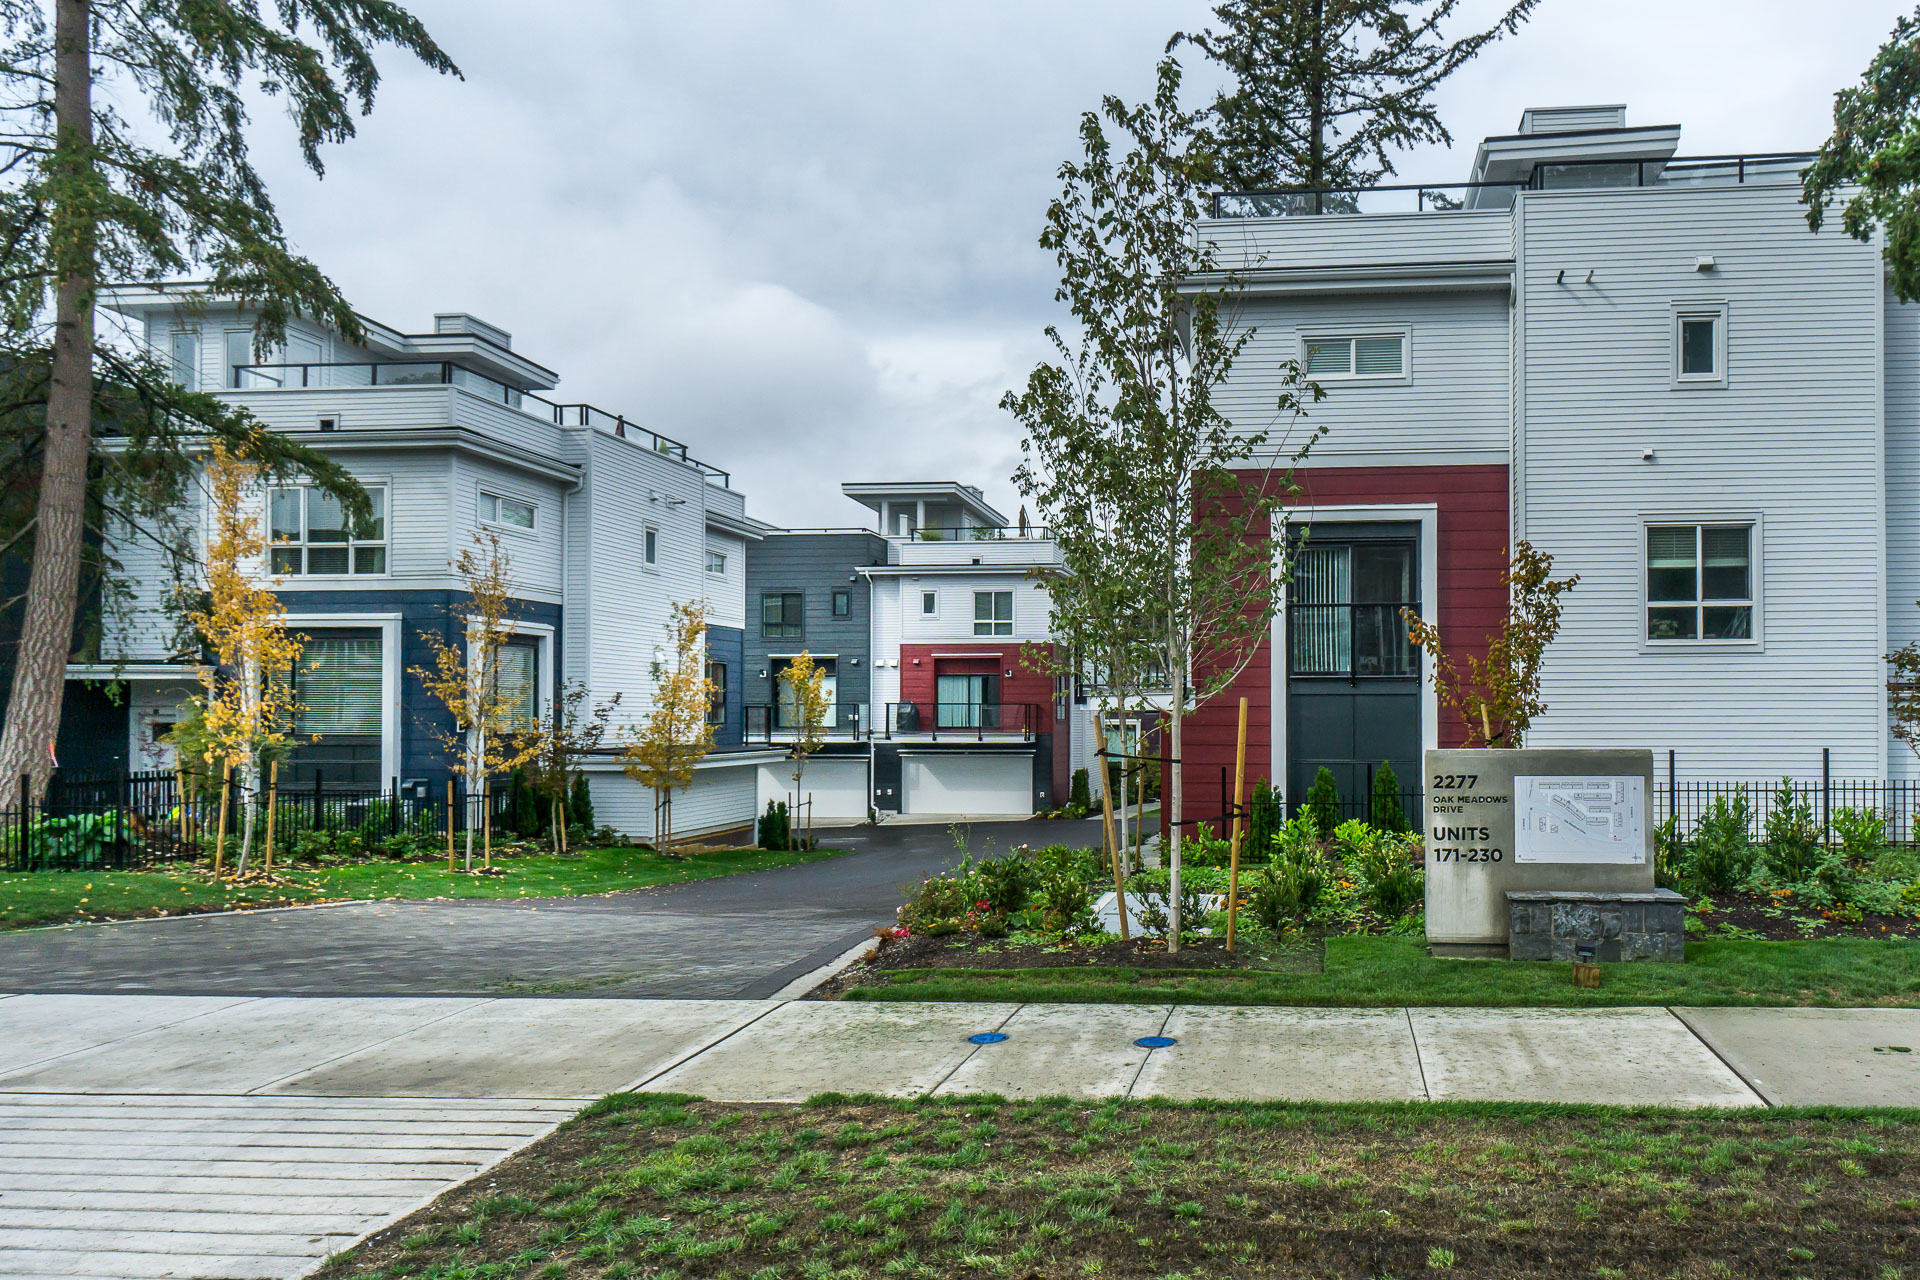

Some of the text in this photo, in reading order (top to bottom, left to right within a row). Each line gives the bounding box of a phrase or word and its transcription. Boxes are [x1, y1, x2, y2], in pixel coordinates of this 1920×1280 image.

[1433, 774, 1478, 789] 2277
[1433, 827, 1490, 841] UNITS
[1433, 848, 1503, 862] 171-230
